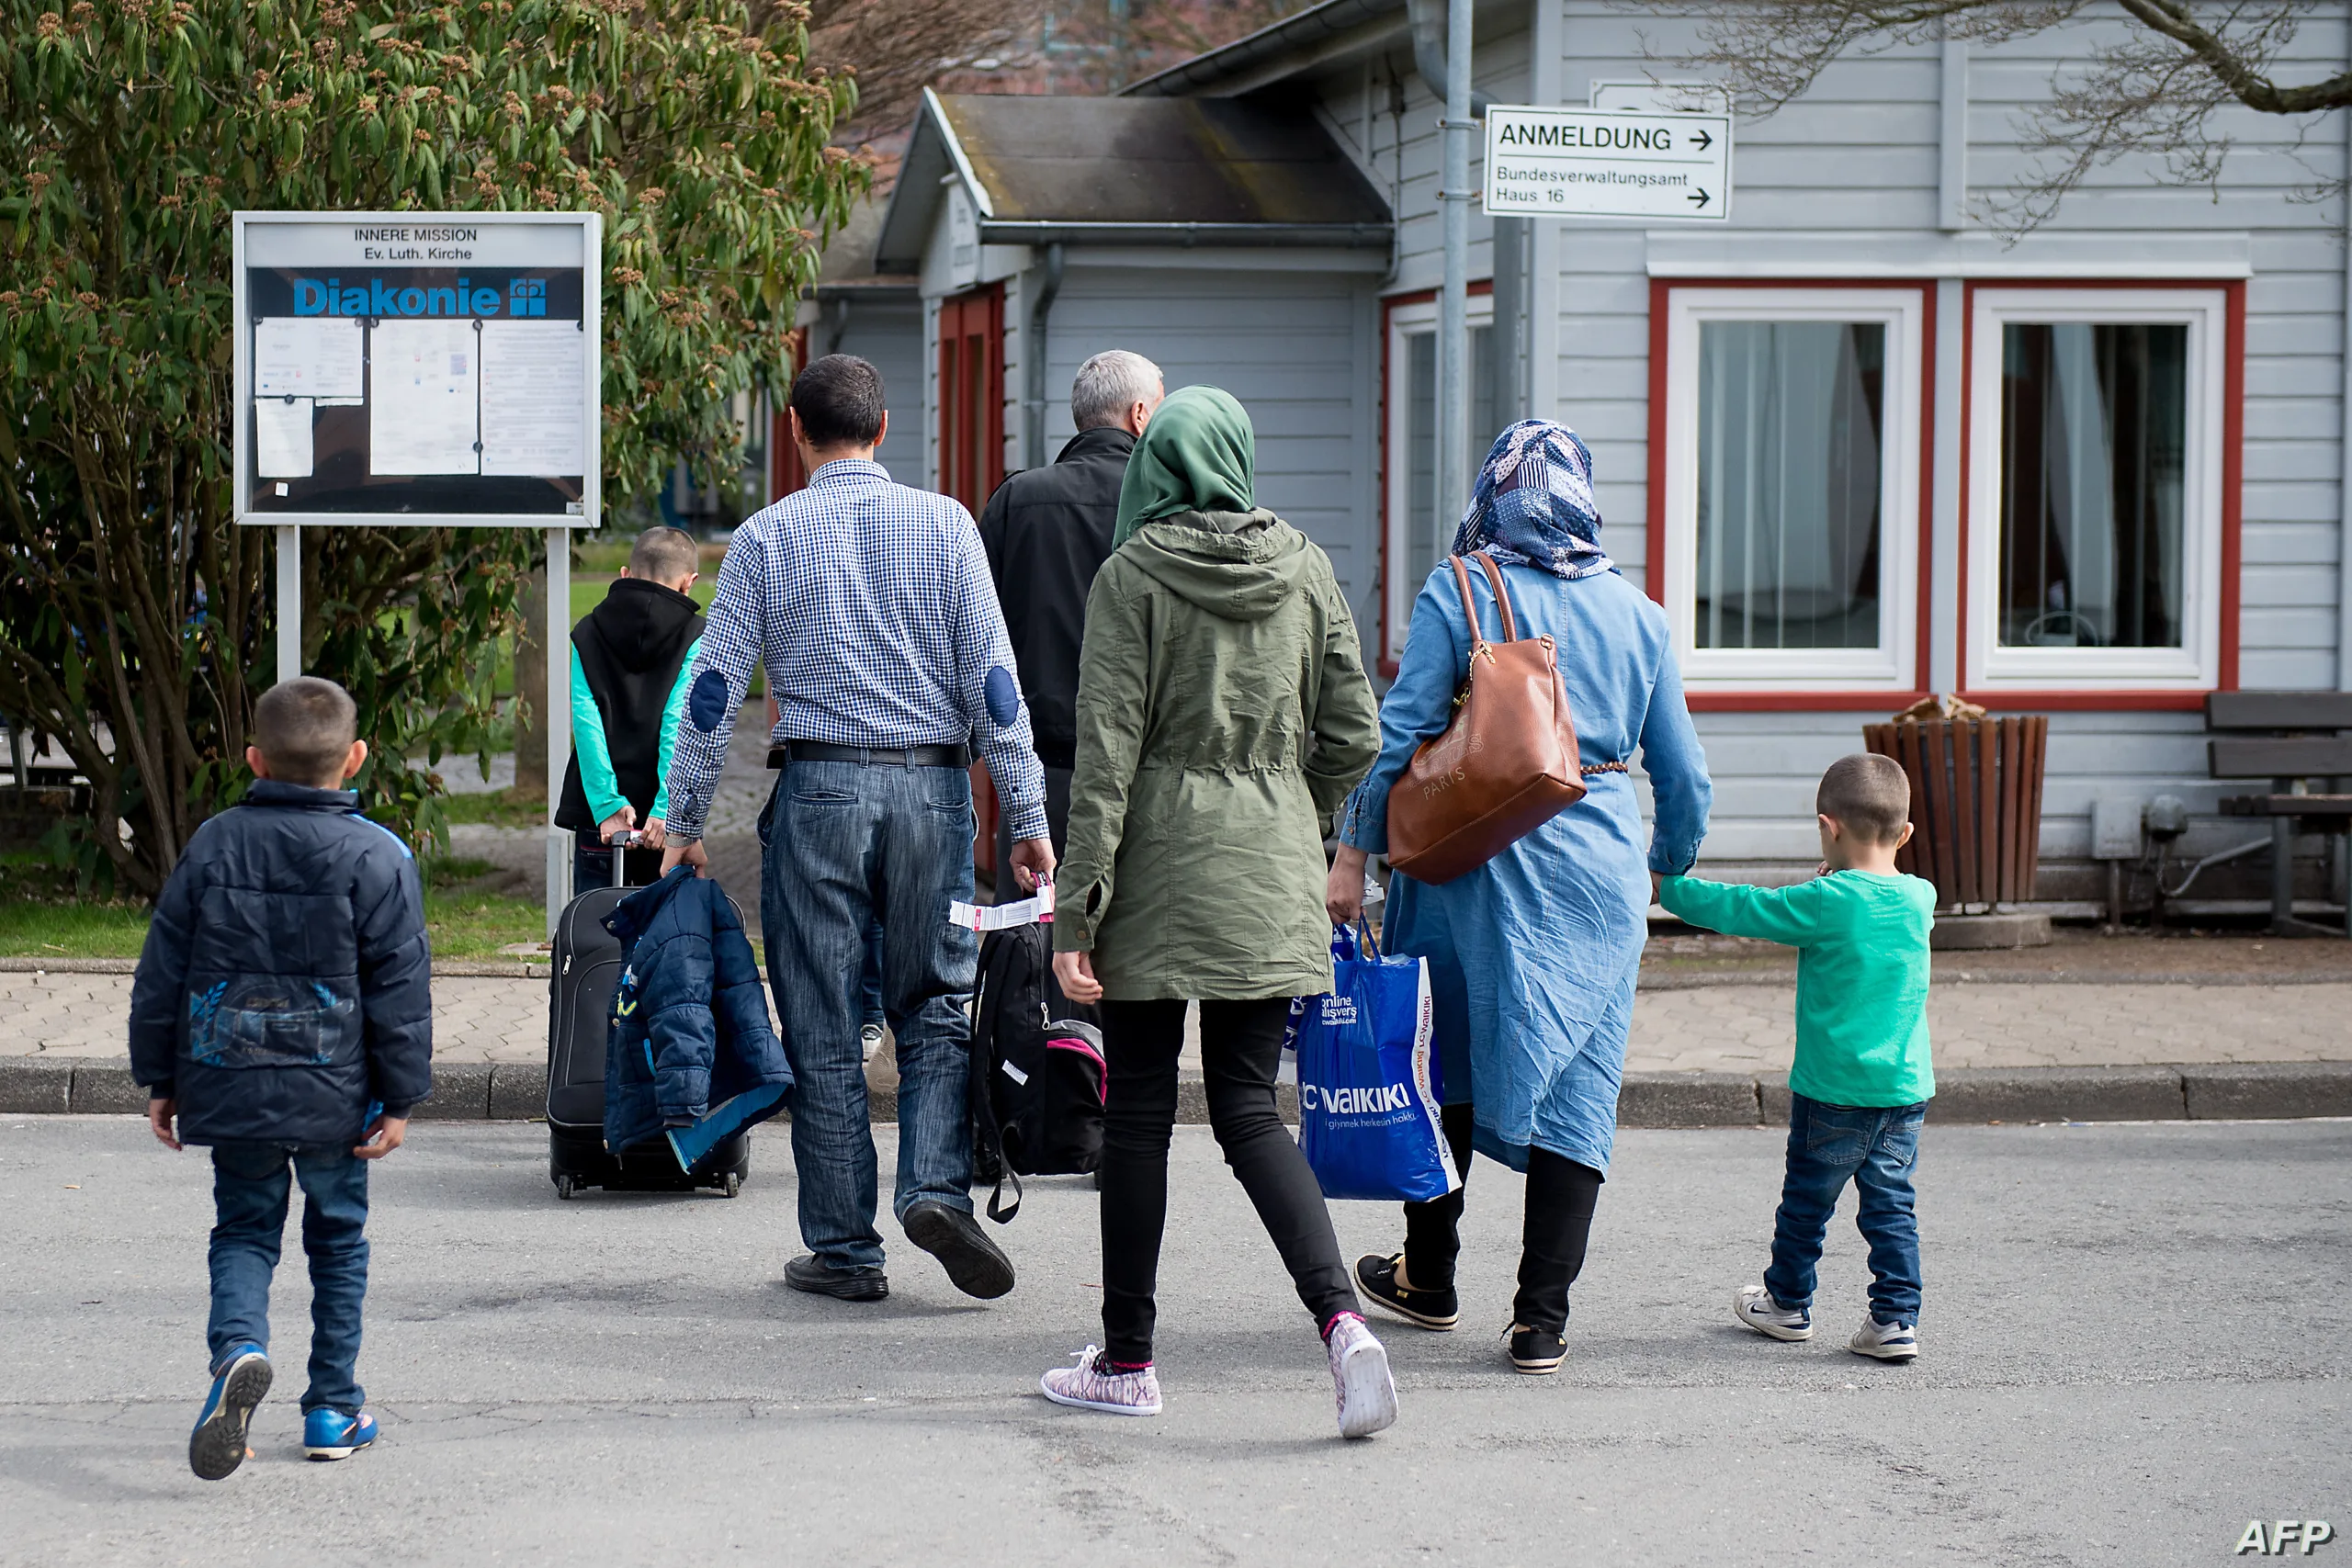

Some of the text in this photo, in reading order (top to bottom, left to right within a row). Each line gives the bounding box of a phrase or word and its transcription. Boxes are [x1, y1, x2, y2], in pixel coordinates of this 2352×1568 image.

[1499, 124, 1671, 151] ANMELDUNG
[1497, 166, 1689, 187] Bundesverwaltungsamt
[1496, 186, 1564, 203] Haus 16
[354, 229, 477, 242] INNERE MISSION
[364, 248, 472, 260] Ev. Luth. Kirche
[293, 277, 501, 316] Diakonie
[1423, 766, 1465, 800] PARIS
[1321, 995, 1351, 1008] online
